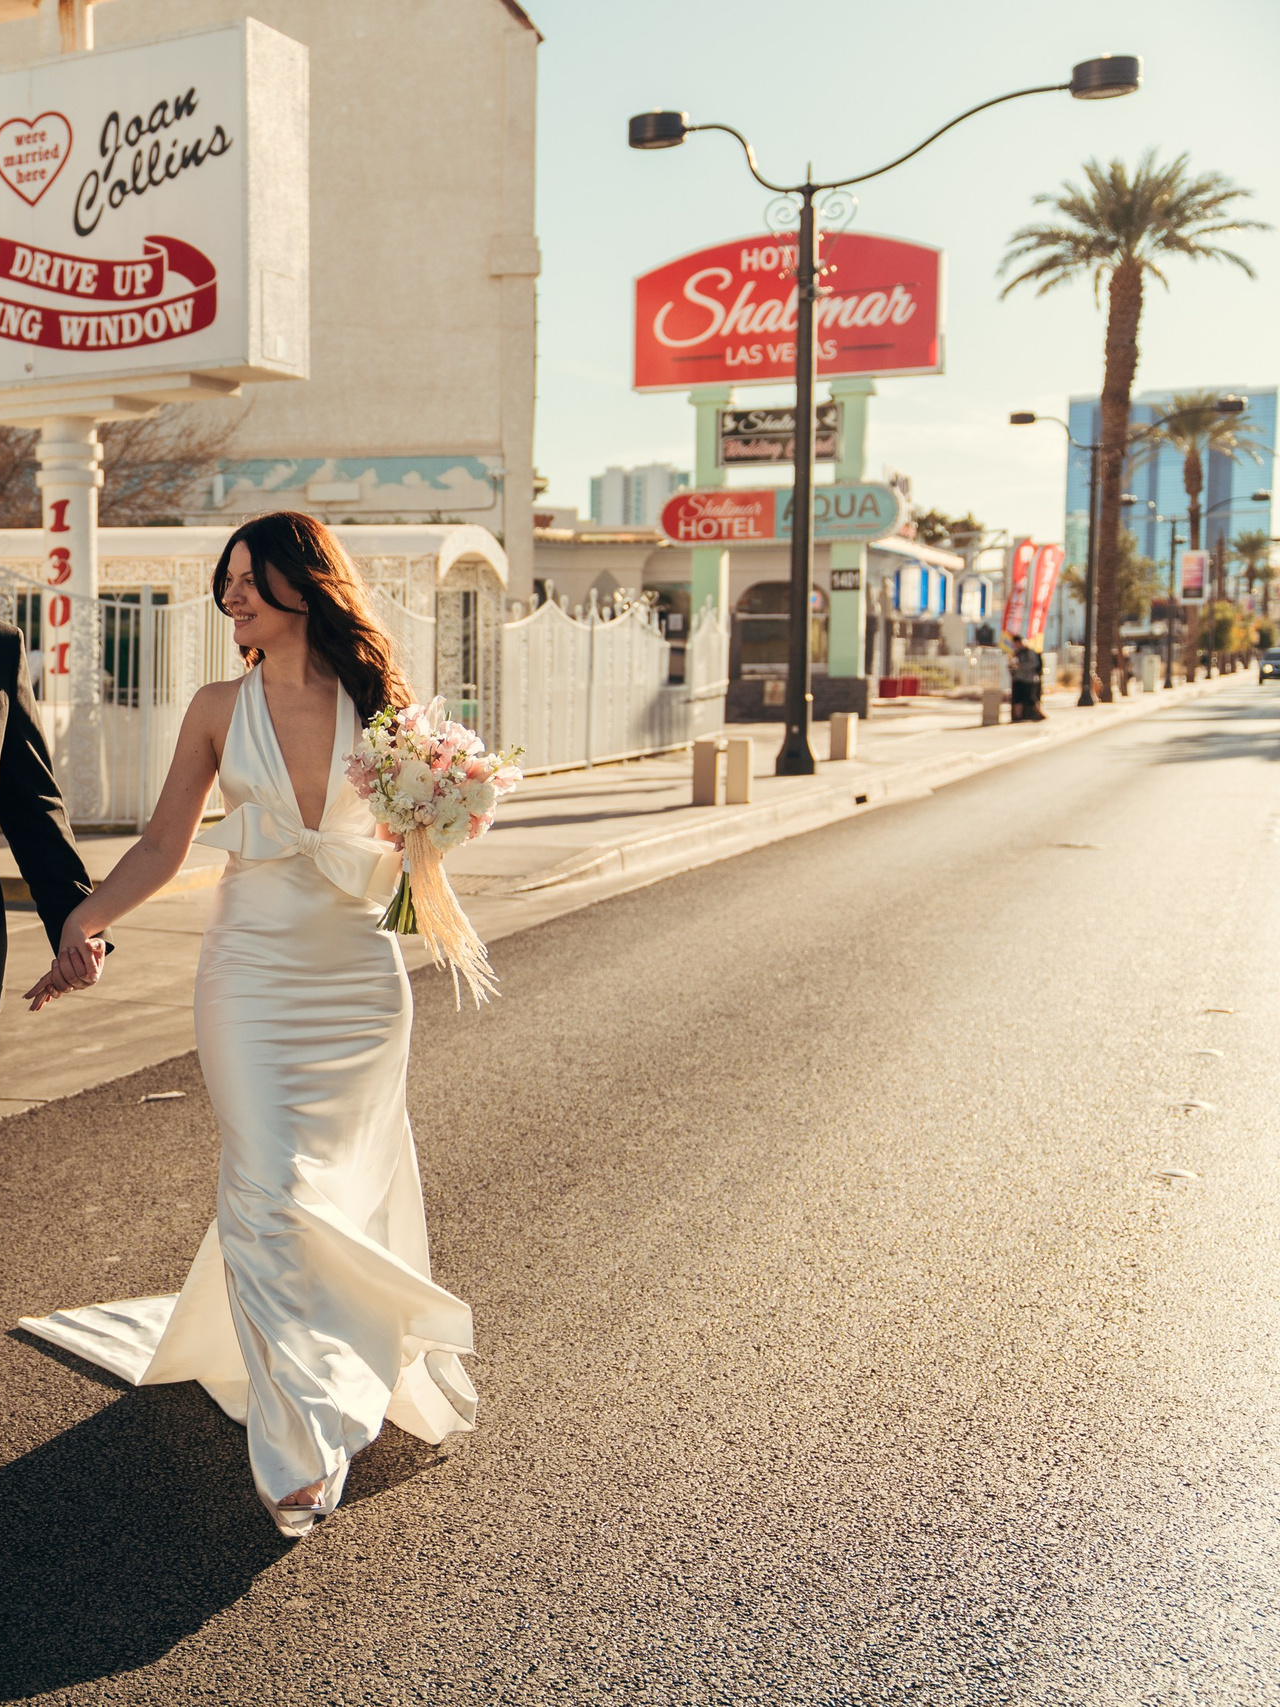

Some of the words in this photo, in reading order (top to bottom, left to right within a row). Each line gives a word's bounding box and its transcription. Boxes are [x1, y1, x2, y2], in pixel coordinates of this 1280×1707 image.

[14, 129, 47, 147] were
[100, 87, 199, 183] Joan
[2, 144, 60, 168] married
[15, 166, 47, 185] here
[73, 125, 234, 237] Collins
[10, 247, 99, 295] DRIVE
[113, 263, 154, 296] UP
[740, 244, 825, 272] HOT
[653, 267, 917, 348] Shalmar
[58, 298, 195, 347] WINDOW
[726, 345, 763, 366] LAS
[766, 339, 838, 363] VEAS
[677, 517, 762, 539] HOTEL
